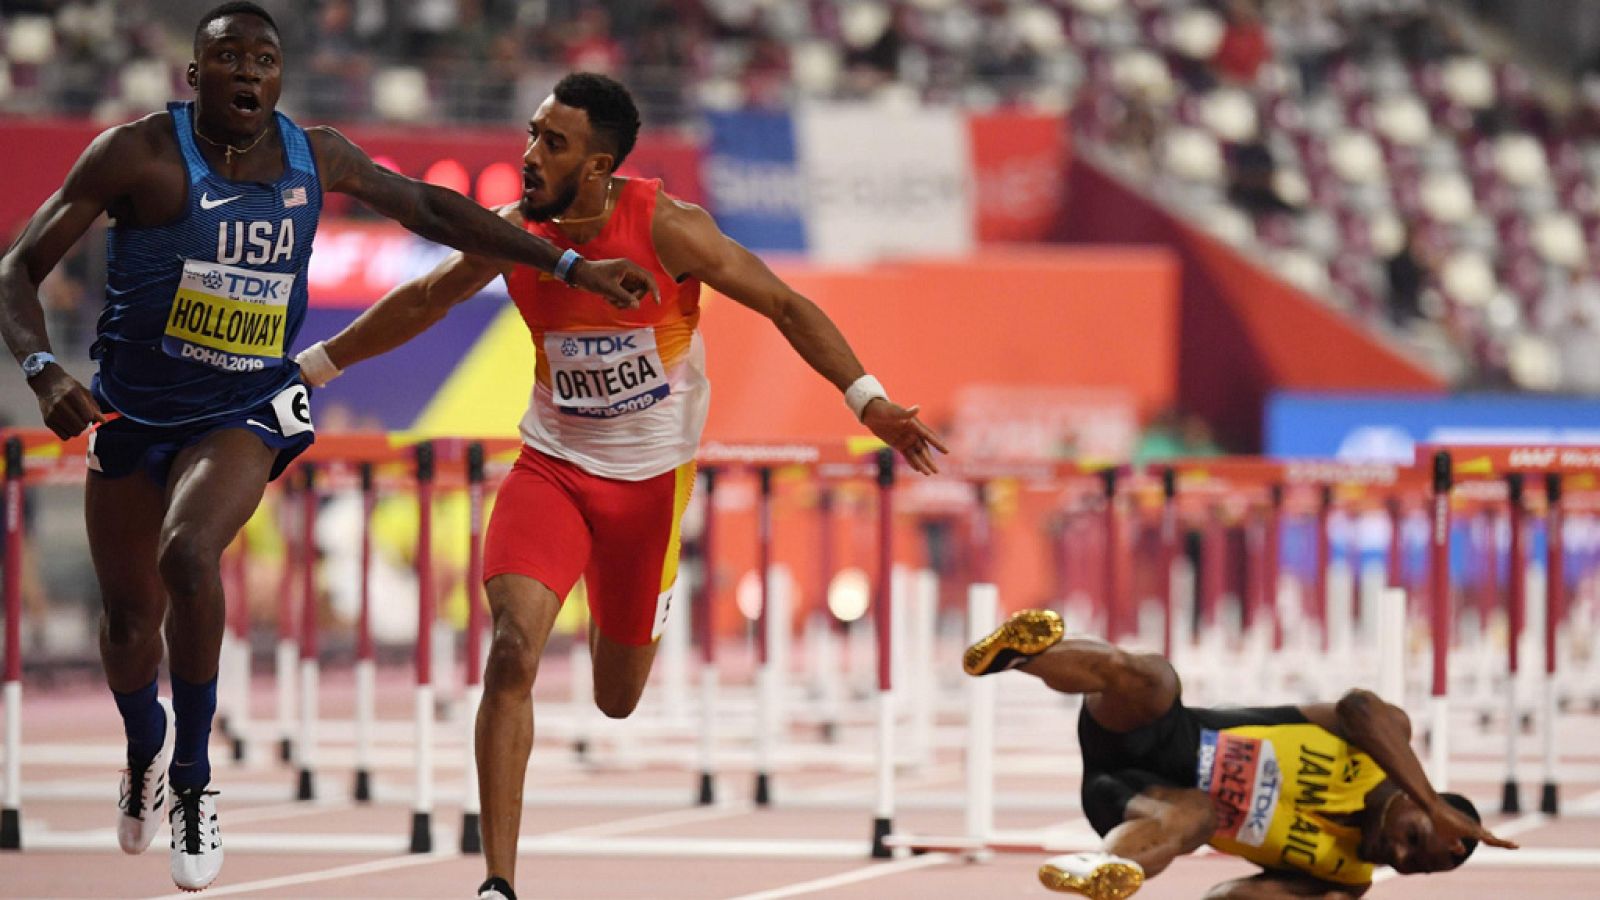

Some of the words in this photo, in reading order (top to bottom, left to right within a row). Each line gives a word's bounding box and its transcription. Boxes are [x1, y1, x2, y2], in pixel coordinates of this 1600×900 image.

[217, 218, 294, 264] USA
[224, 272, 282, 299] TDK
[172, 298, 282, 346] HOLLOWAY
[578, 335, 637, 356] TDK
[556, 354, 658, 400] ORTEGA
[1247, 777, 1277, 830] TDK
[1281, 744, 1336, 866] JAMAIC
